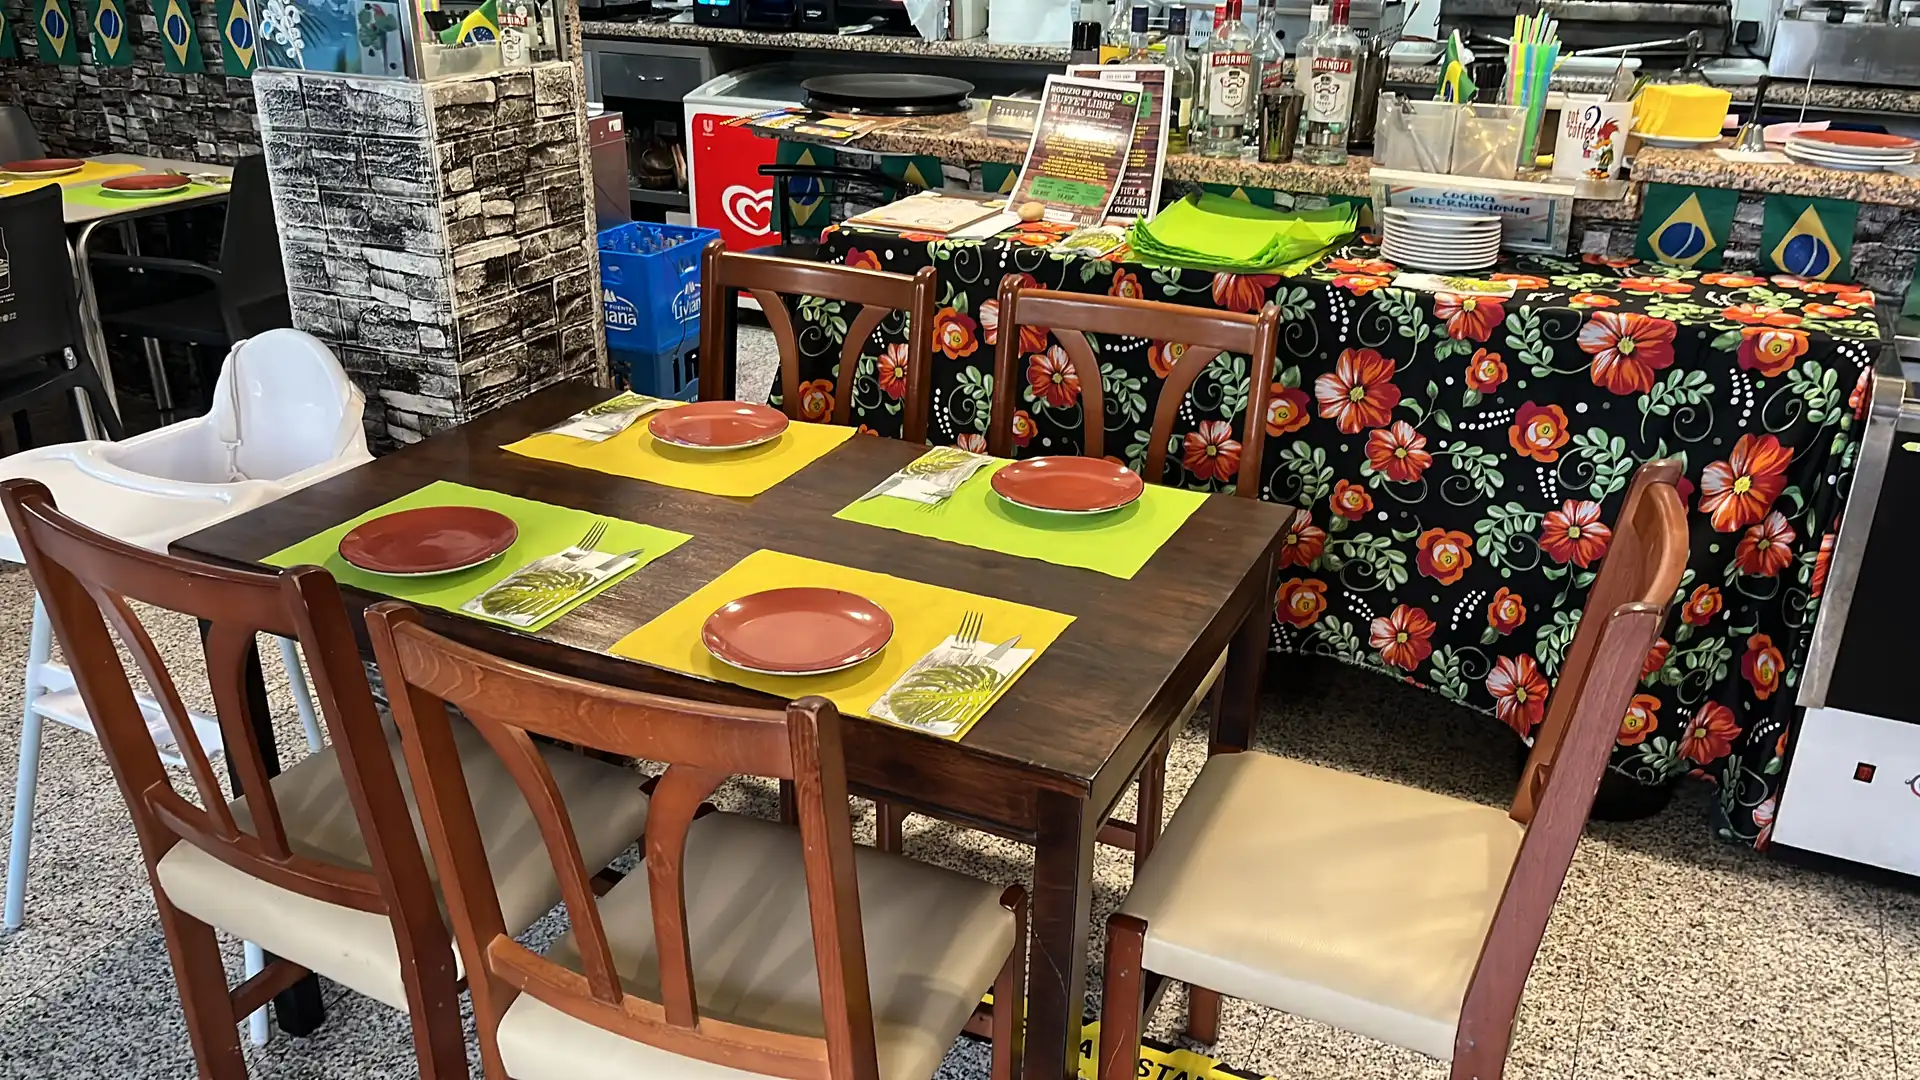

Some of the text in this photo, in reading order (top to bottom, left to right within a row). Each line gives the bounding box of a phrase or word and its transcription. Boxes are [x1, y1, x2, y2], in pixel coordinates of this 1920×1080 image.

[1050, 85, 1122, 101] RODIZIO DE BOTECO
[1050, 94, 1115, 111] BUFFET LIBRE
[1567, 122, 1596, 140] coffee
